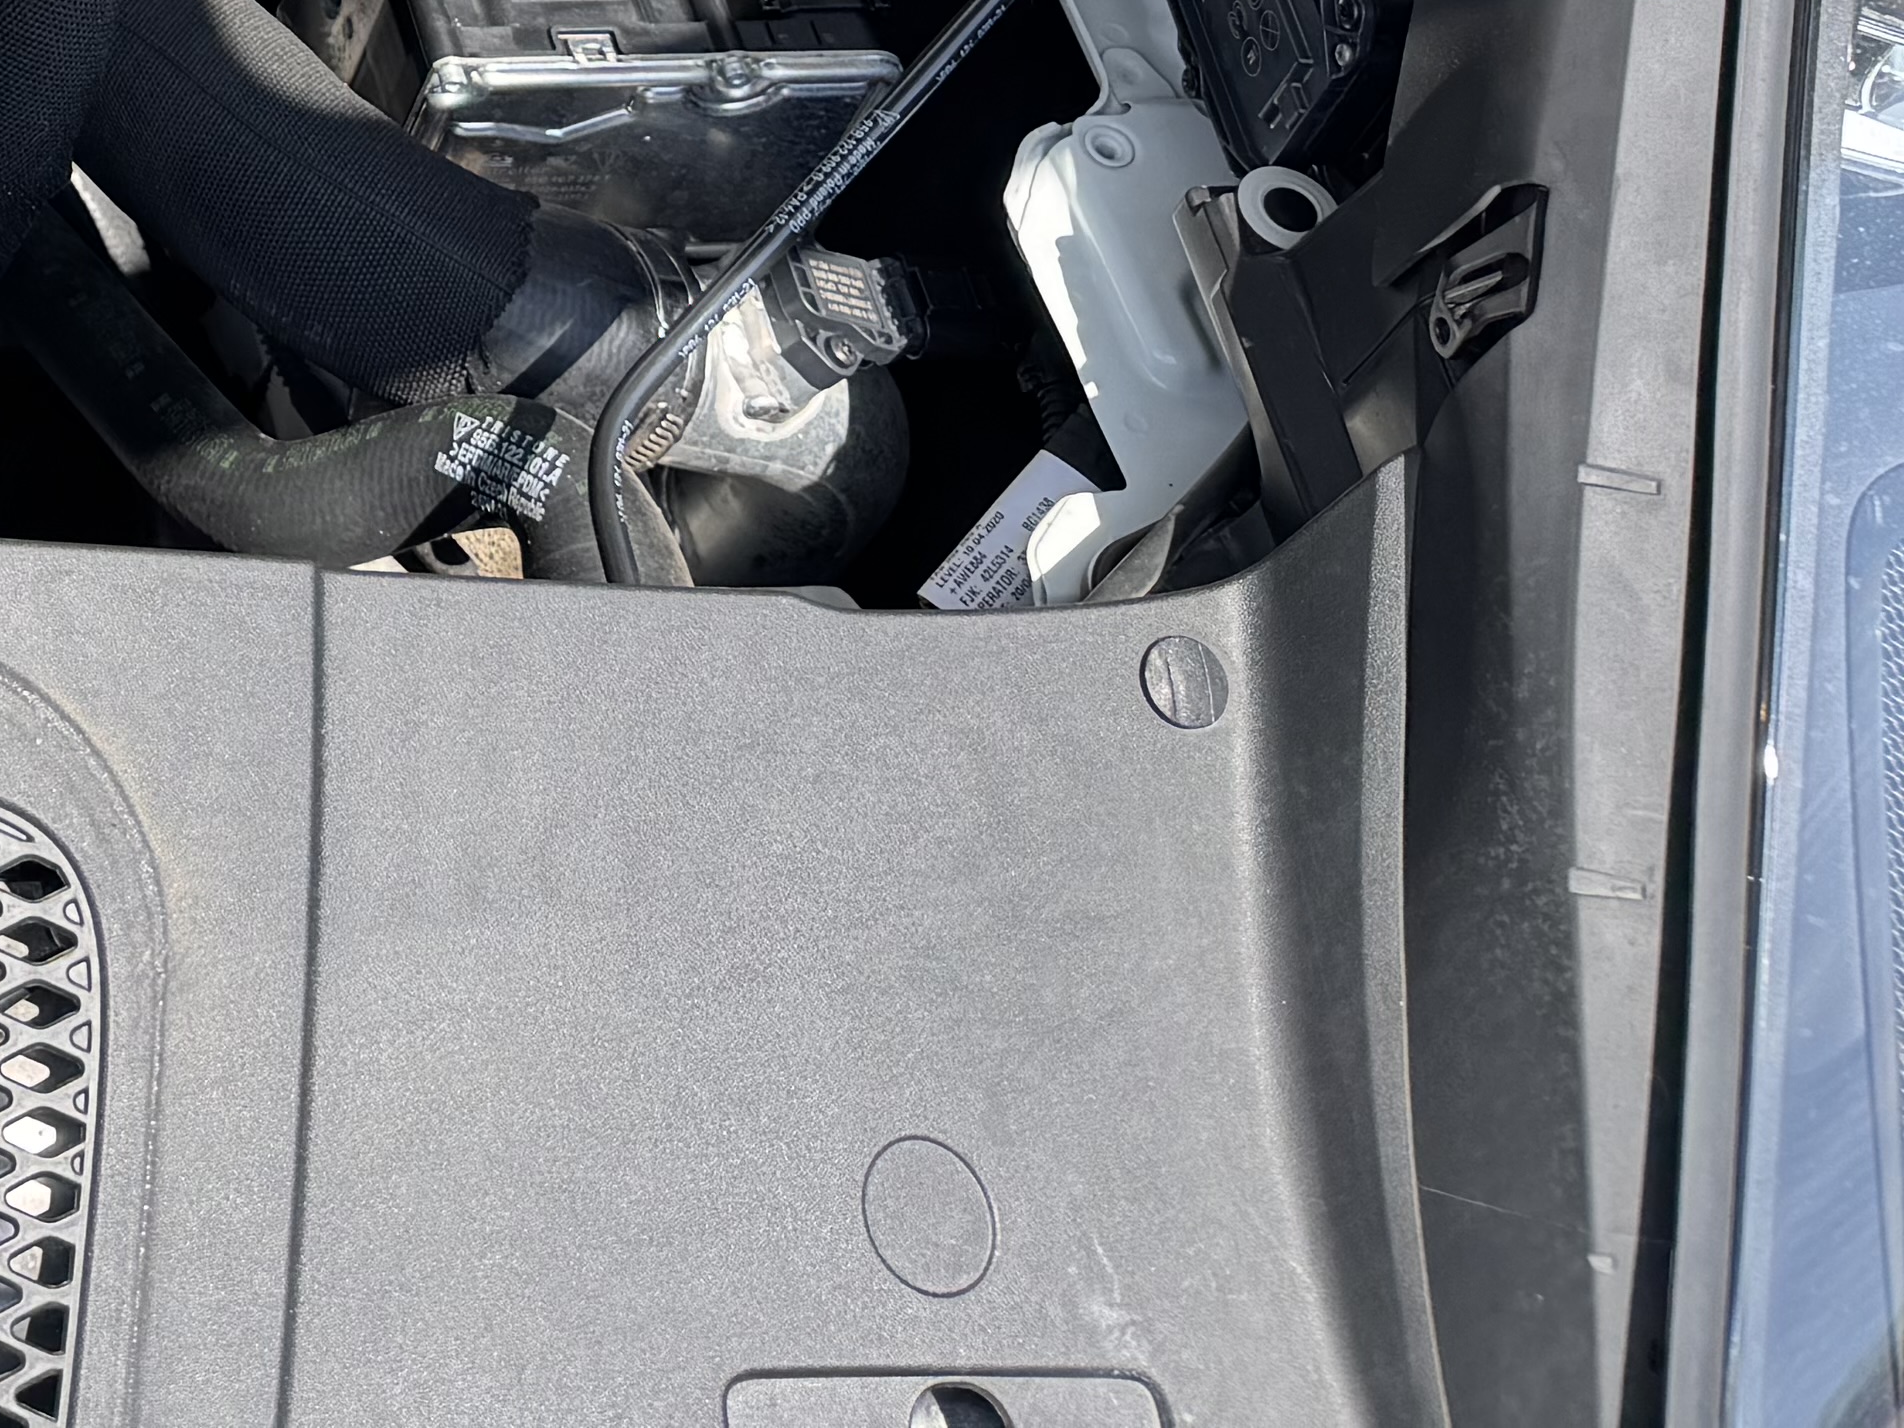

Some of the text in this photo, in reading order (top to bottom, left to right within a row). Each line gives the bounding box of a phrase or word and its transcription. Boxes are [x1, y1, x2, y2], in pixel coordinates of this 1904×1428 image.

[846, 135, 878, 168] Made
[807, 171, 845, 210] Poland
[475, 472, 512, 501] Czech
[505, 488, 549, 523] Republic
[933, 555, 965, 589] LEVEL:
